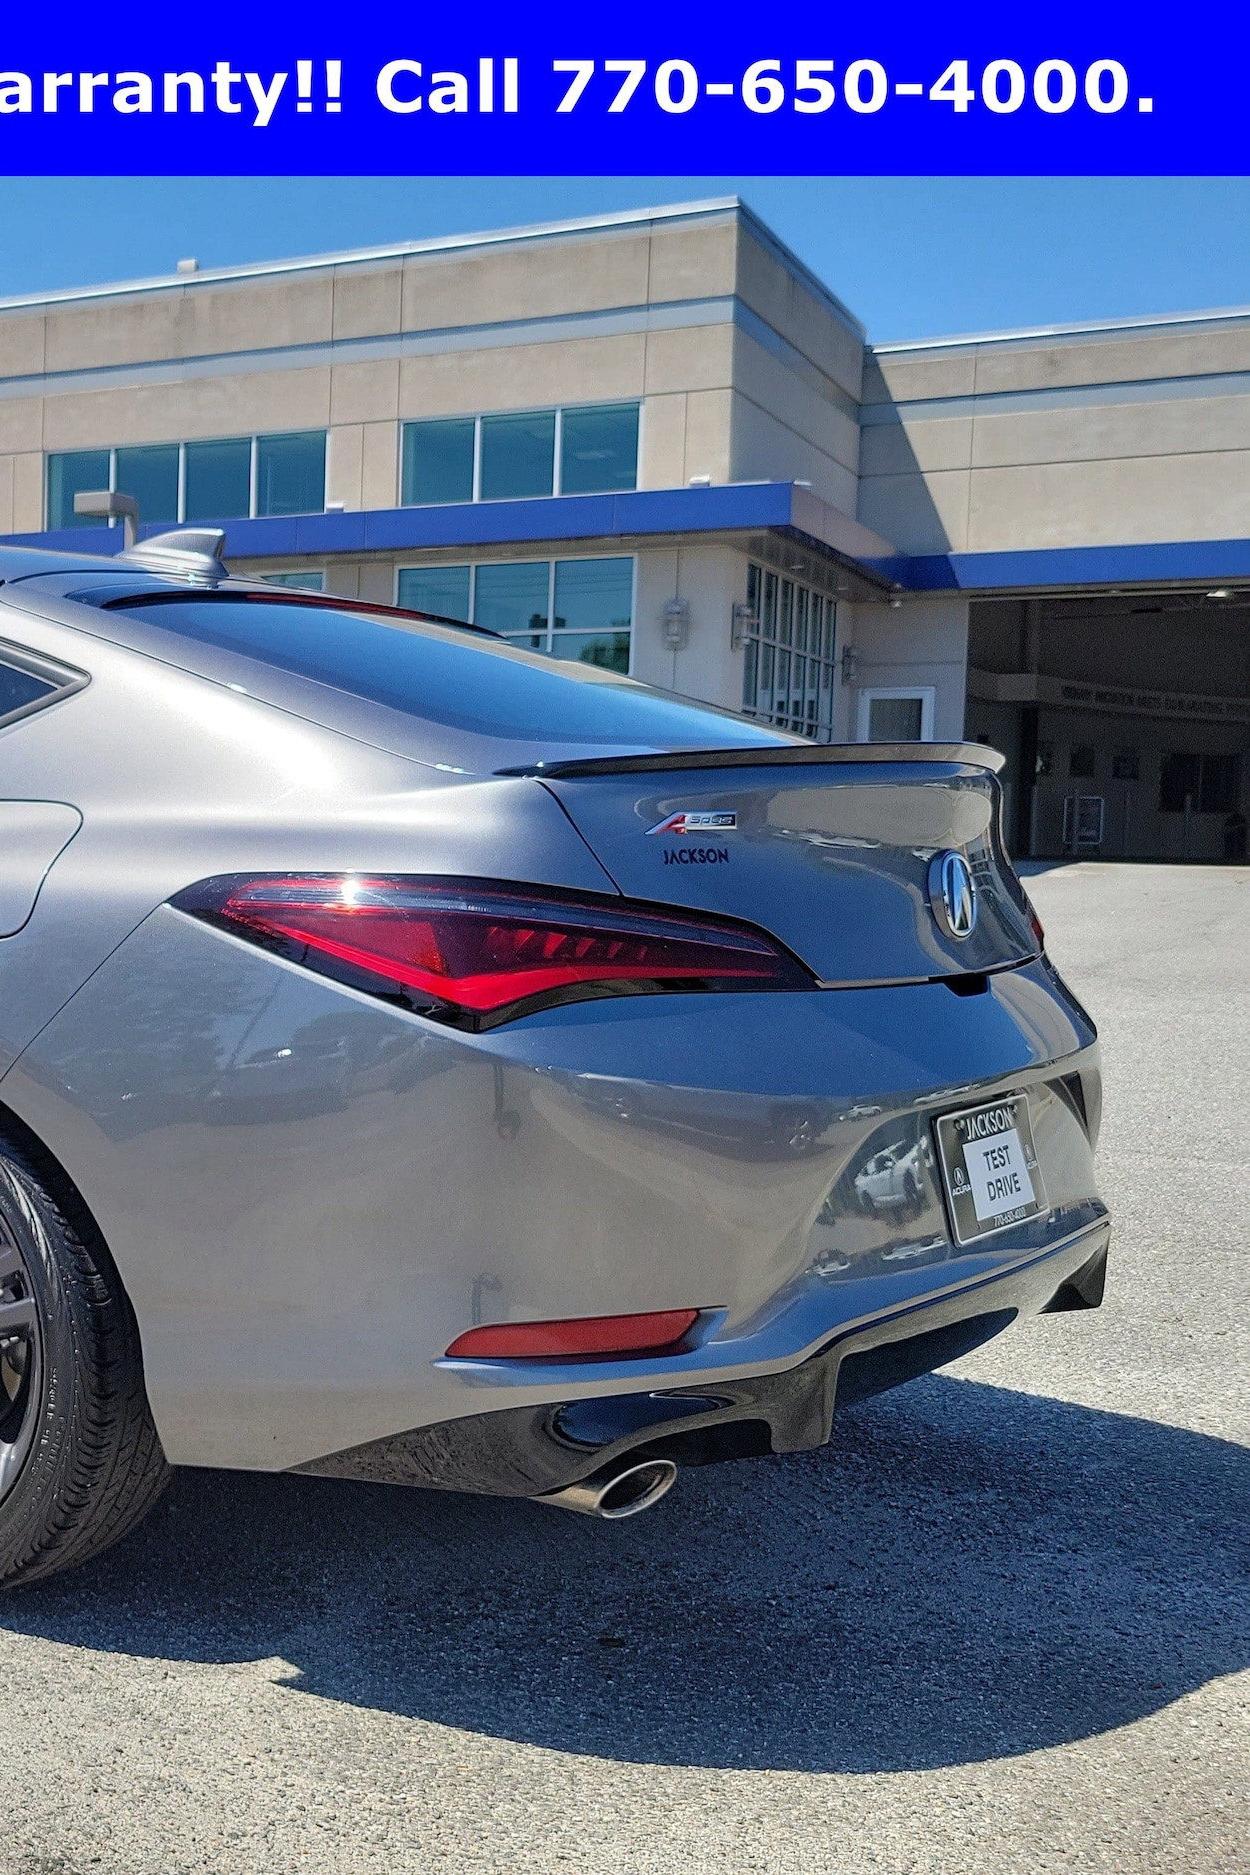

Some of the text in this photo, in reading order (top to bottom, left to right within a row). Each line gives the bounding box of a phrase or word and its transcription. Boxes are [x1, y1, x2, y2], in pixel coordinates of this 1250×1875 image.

[663, 848, 729, 865] JACKSON
[966, 1106, 1013, 1140] JACKSON
[982, 1145, 1011, 1171] TEST
[986, 1172, 1021, 1202] DRIVE
